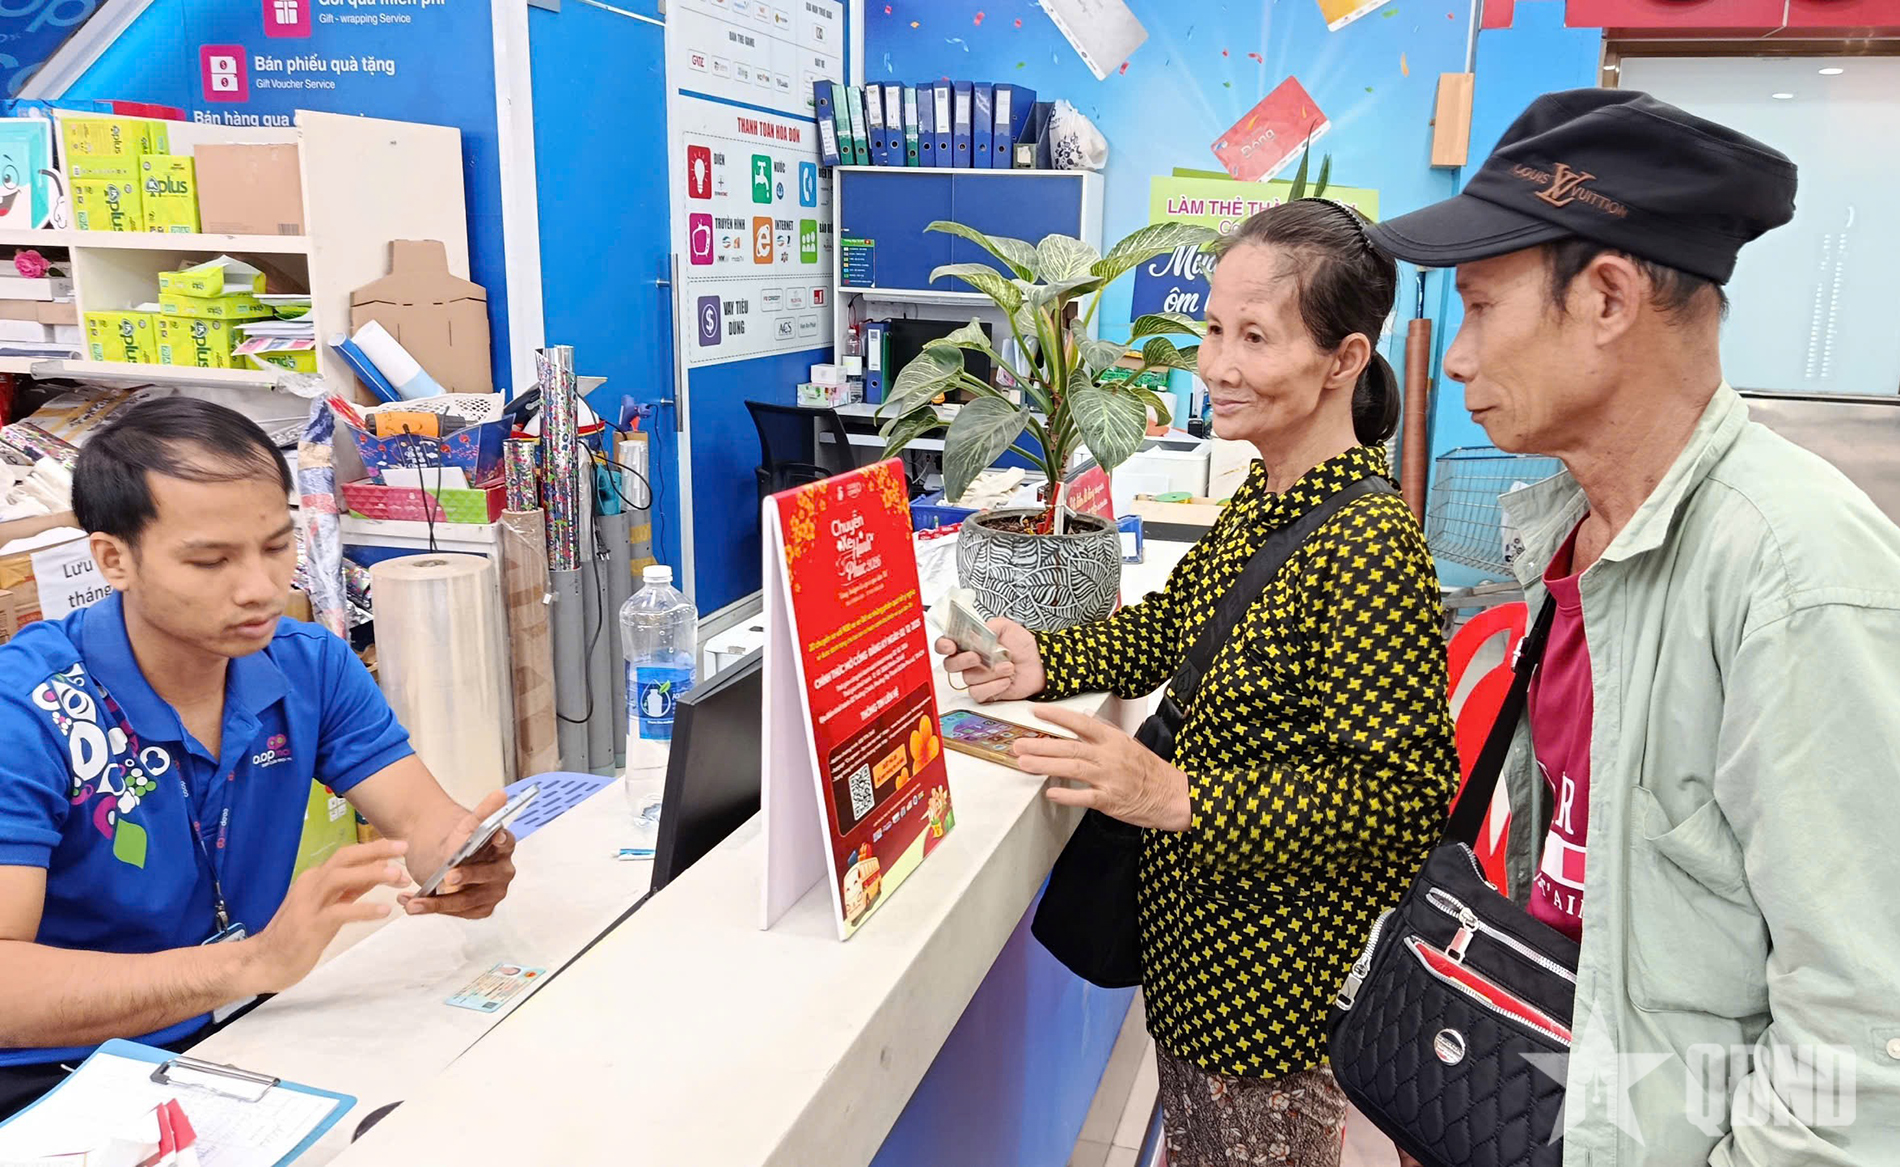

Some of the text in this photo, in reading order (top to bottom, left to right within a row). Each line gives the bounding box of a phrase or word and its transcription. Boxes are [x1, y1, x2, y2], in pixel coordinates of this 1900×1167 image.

[319, 14, 334, 23] Gift
[341, 14, 378, 25] wrapping
[380, 13, 411, 23] Service
[255, 53, 396, 77] Bán phiếu quà tặng
[256, 79, 335, 89] Gift Voucher Service
[193, 110, 221, 125] Bán
[225, 109, 259, 127] hàng
[737, 117, 758, 136] THANH
[759, 120, 774, 138] TOÁN
[789, 126, 800, 143] ĐƠN
[1511, 163, 1550, 184] LOUIS
[1167, 194, 1204, 215] LÀM
[1209, 194, 1243, 216] THẺ
[1571, 186, 1629, 218] VUITTON
[715, 215, 733, 230] TRUYỀN
[775, 219, 793, 231] INTERNET
[723, 298, 748, 316] VAY TIÊU
[1164, 287, 1199, 312] ôm
[728, 318, 745, 335] DÙNG
[779, 322, 792, 334] ACS
[63, 560, 93, 578] Lưu
[68, 585, 112, 607] tháng
